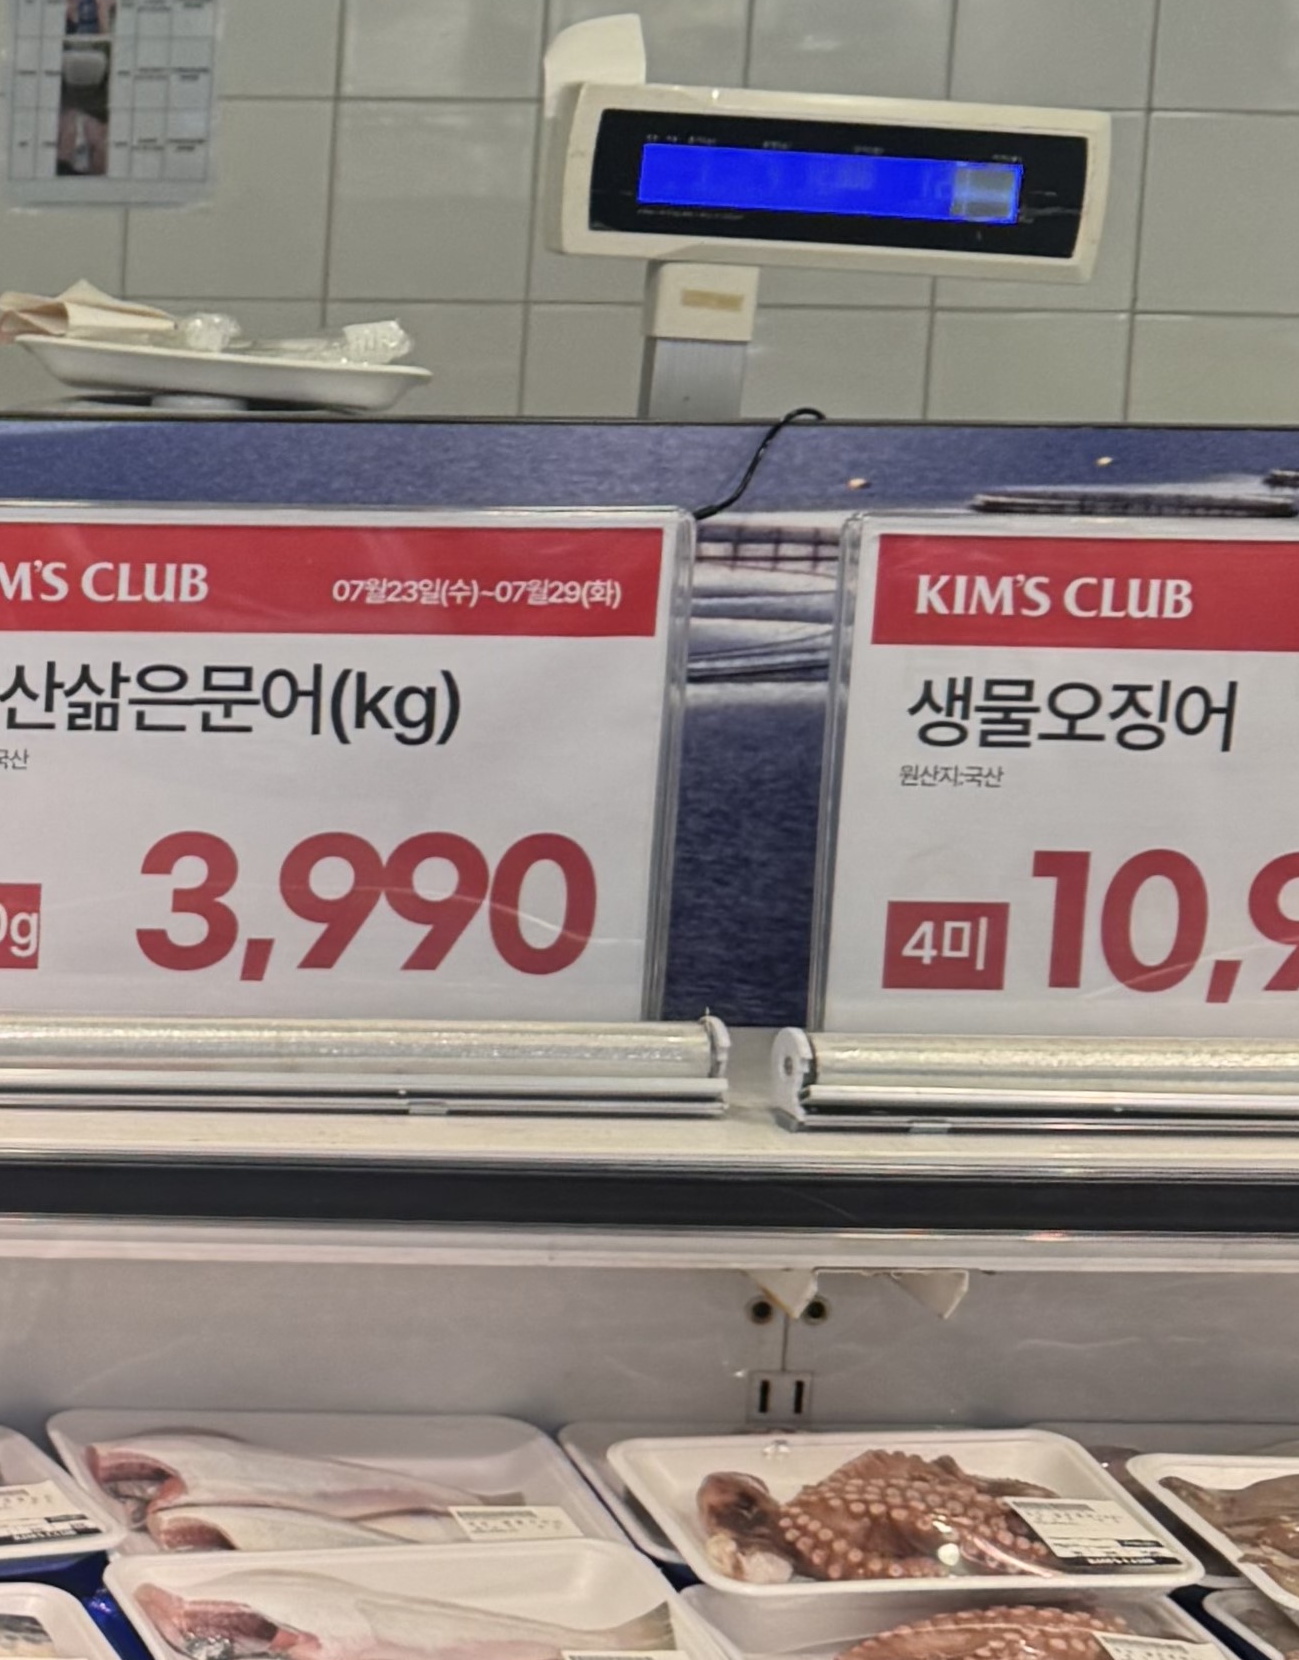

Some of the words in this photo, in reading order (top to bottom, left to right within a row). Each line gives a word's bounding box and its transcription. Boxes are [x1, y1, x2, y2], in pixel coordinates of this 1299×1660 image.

[81, 561, 209, 602] CLUB
[915, 573, 1051, 617] KIM'S
[1063, 577, 1194, 619] CLUB
[906, 675, 1239, 753] 생물오징어
[900, 764, 1004, 788] 원산지:국산
[135, 830, 596, 982] 3,990
[902, 917, 988, 972] 4미
